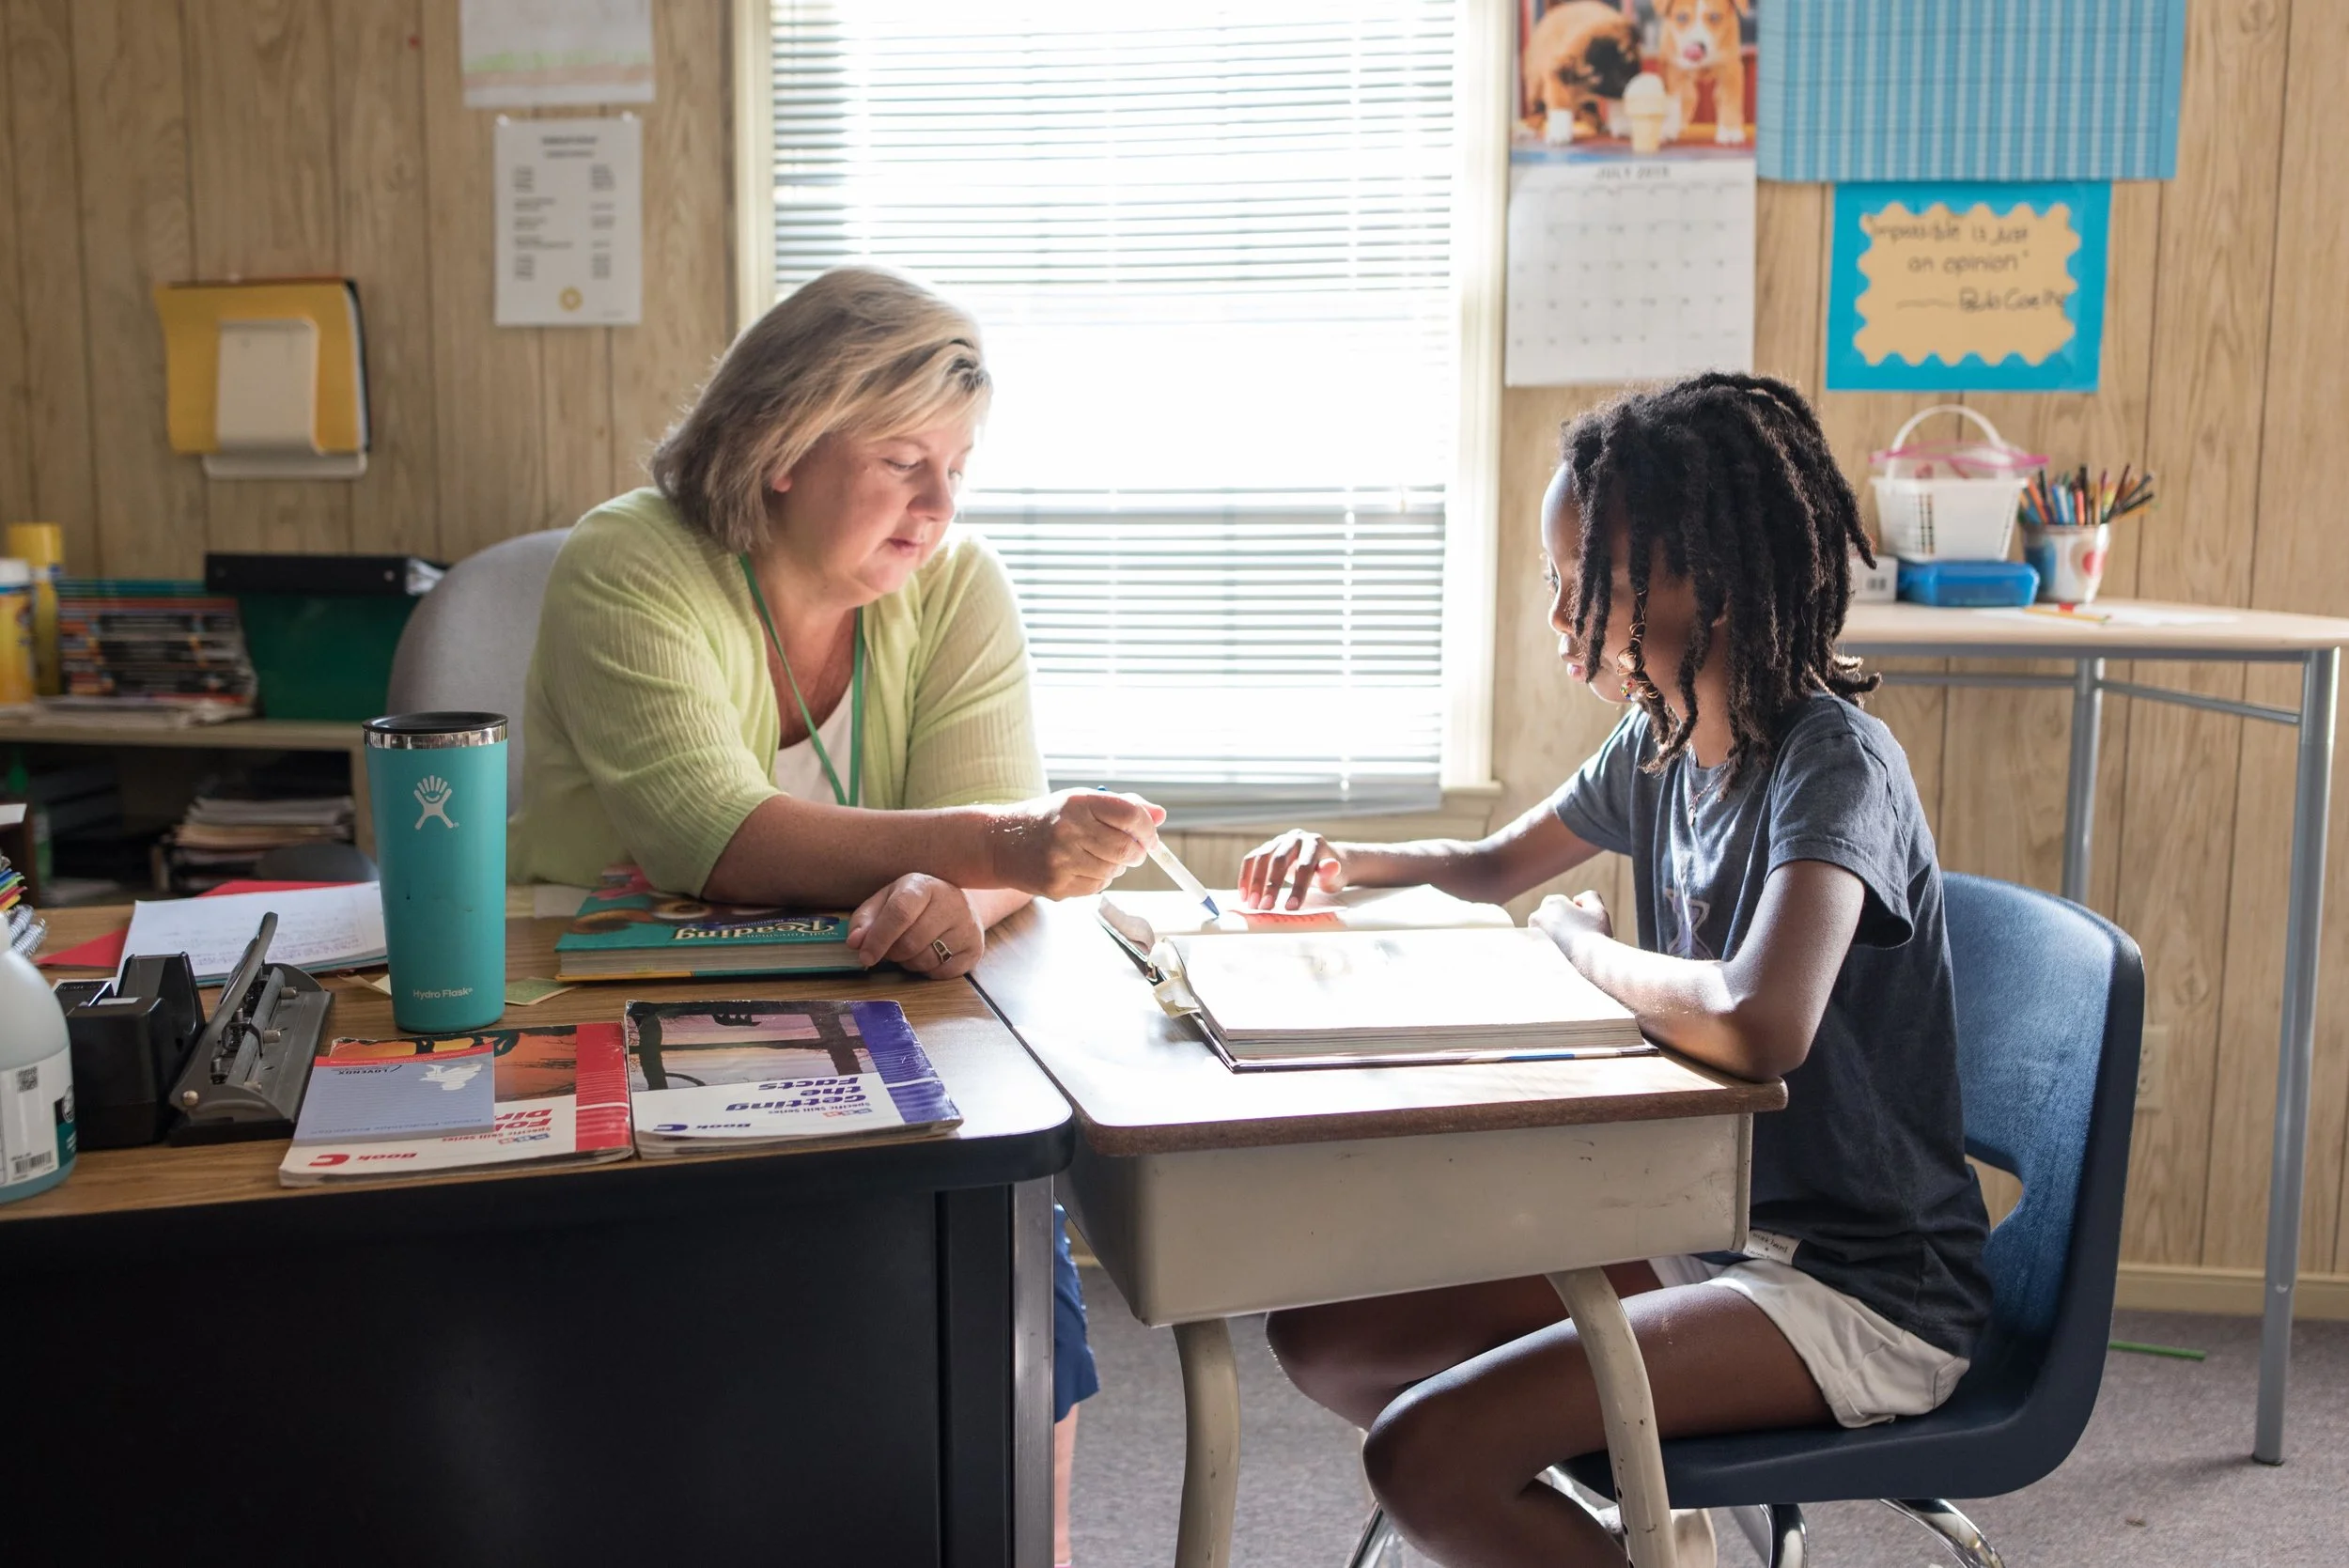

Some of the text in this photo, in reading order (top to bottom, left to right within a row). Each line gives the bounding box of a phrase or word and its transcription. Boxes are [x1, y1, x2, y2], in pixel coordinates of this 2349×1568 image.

[675, 921, 834, 939] Reading
[413, 989, 441, 1000] Hydro
[758, 1078, 859, 1091] Facts
[801, 1086, 863, 1096] the
[725, 1094, 866, 1111] Getting
[654, 1124, 689, 1132] C
[308, 1152, 417, 1167] Book C
